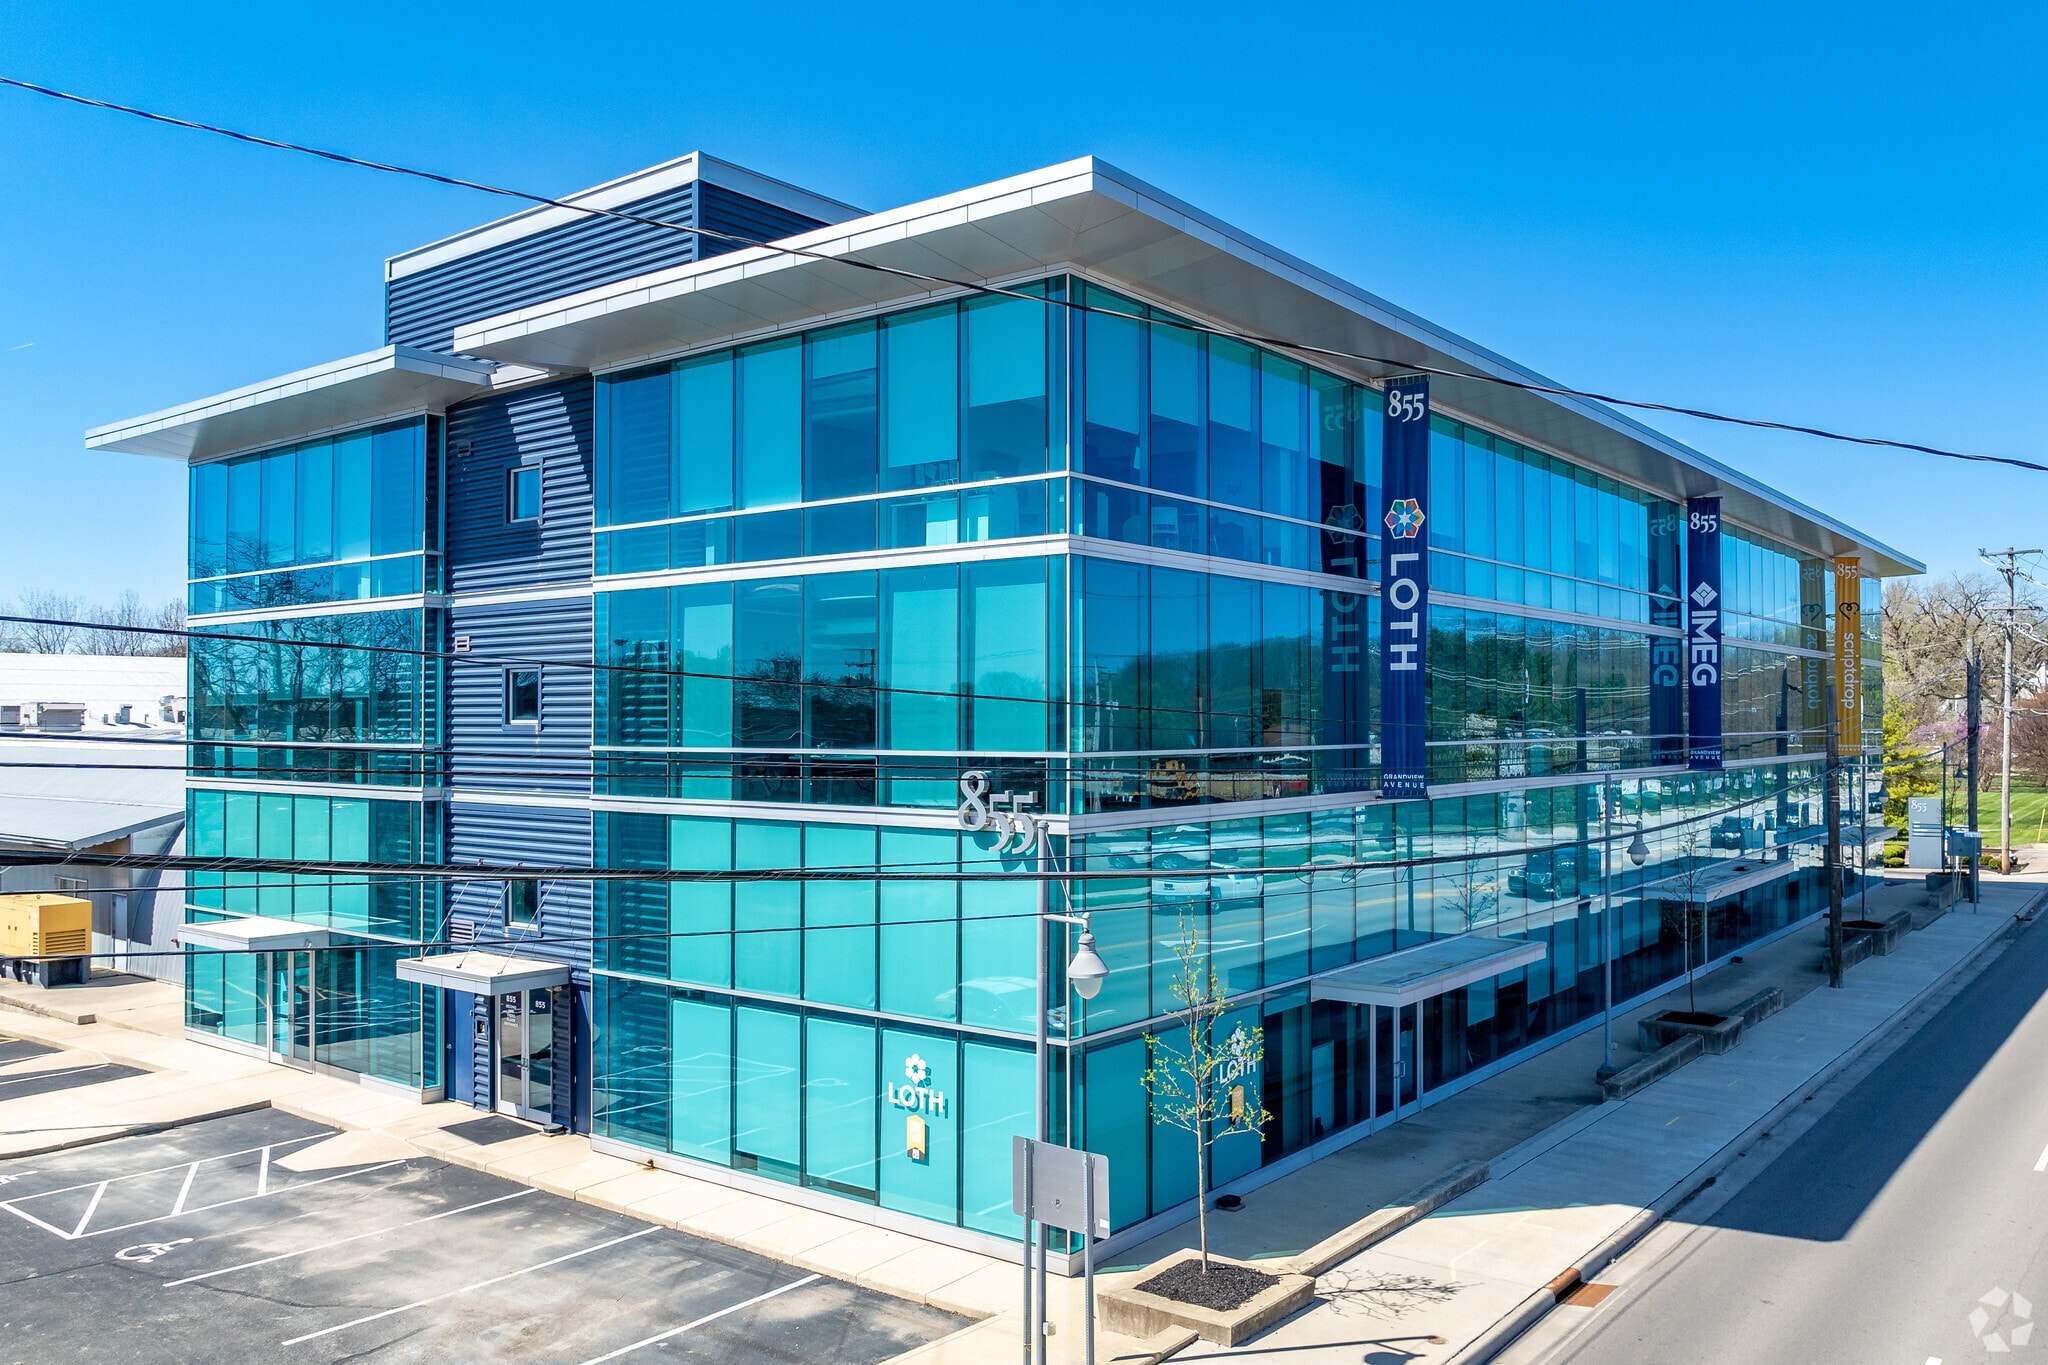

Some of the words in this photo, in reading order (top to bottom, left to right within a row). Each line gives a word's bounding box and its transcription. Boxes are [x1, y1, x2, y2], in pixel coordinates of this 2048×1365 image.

[1388, 390, 1425, 422] 855
[1690, 512, 1717, 533] 855
[1837, 563, 1858, 579] 855
[1389, 552, 1420, 671] LOTH
[1691, 610, 1718, 687] IMEG
[1840, 632, 1860, 709] scriptdrop
[1383, 773, 1425, 781] GRANDVIEW
[1383, 781, 1425, 789] AVENUE
[958, 770, 1039, 855] 855
[1911, 799, 1928, 813] 855
[506, 995, 516, 1003] 855
[535, 1000, 546, 1009] 855
[1220, 1053, 1257, 1084] LOTH
[888, 1081, 944, 1113] LOTH
